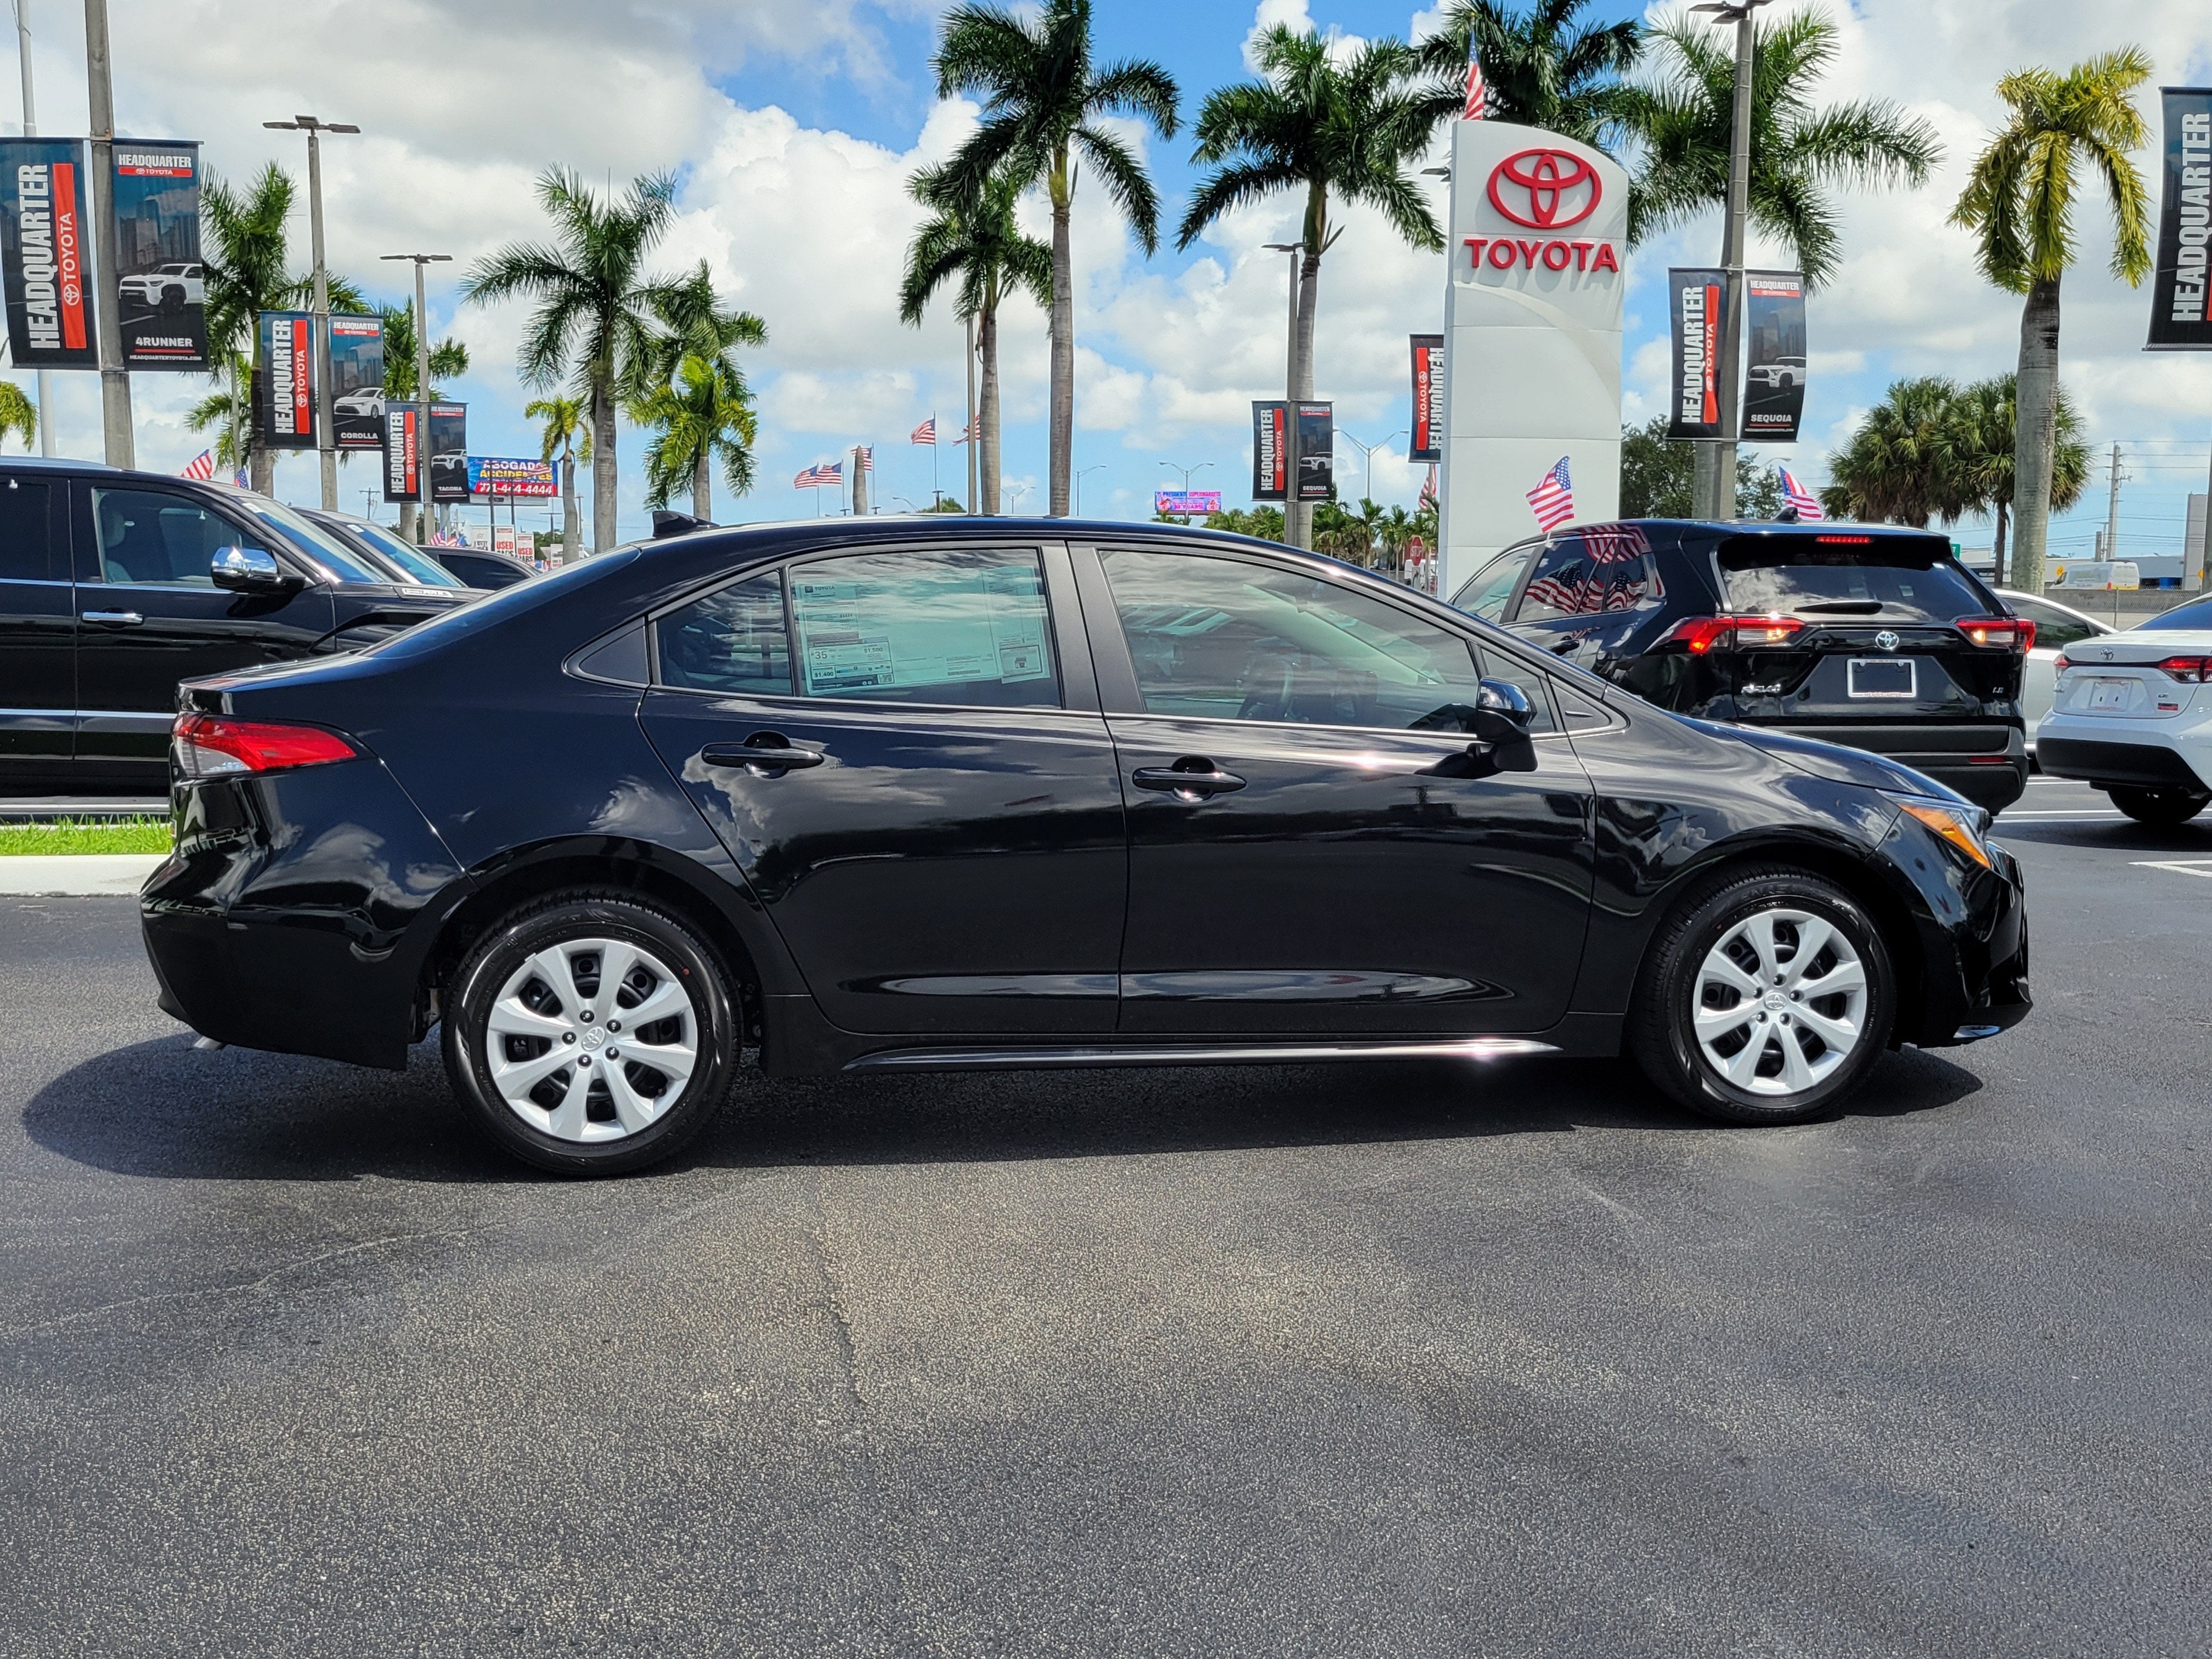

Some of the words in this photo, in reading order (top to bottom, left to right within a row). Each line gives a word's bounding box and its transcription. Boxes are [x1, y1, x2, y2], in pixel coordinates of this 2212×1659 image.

[119, 154, 192, 168] HEADQUARTER
[2171, 112, 2212, 322] HEADQUARTER
[18, 165, 60, 349] HEADQUARTER
[59, 212, 74, 281] TOYOTA
[1464, 238, 1619, 272] TOYOTA
[1751, 280, 1799, 290] HEADQUARTER
[136, 337, 193, 347] 4RUNNER
[334, 321, 379, 330] HEADQUARTER
[1681, 286, 1706, 424] HEADQUARTER
[1706, 323, 1714, 374] TOYOTA
[273, 320, 295, 433] HEADQUARTER
[297, 350, 305, 392] TOYOTA
[1428, 348, 1444, 450] HEADQUARTER
[1751, 414, 1792, 423] SEQUOIA
[390, 411, 405, 493] HEADQUARTER
[1261, 409, 1275, 491] HEADQUARTER
[496, 541, 514, 550] USED
[1410, 545, 1422, 557] STOP
[815, 651, 828, 659] 35
